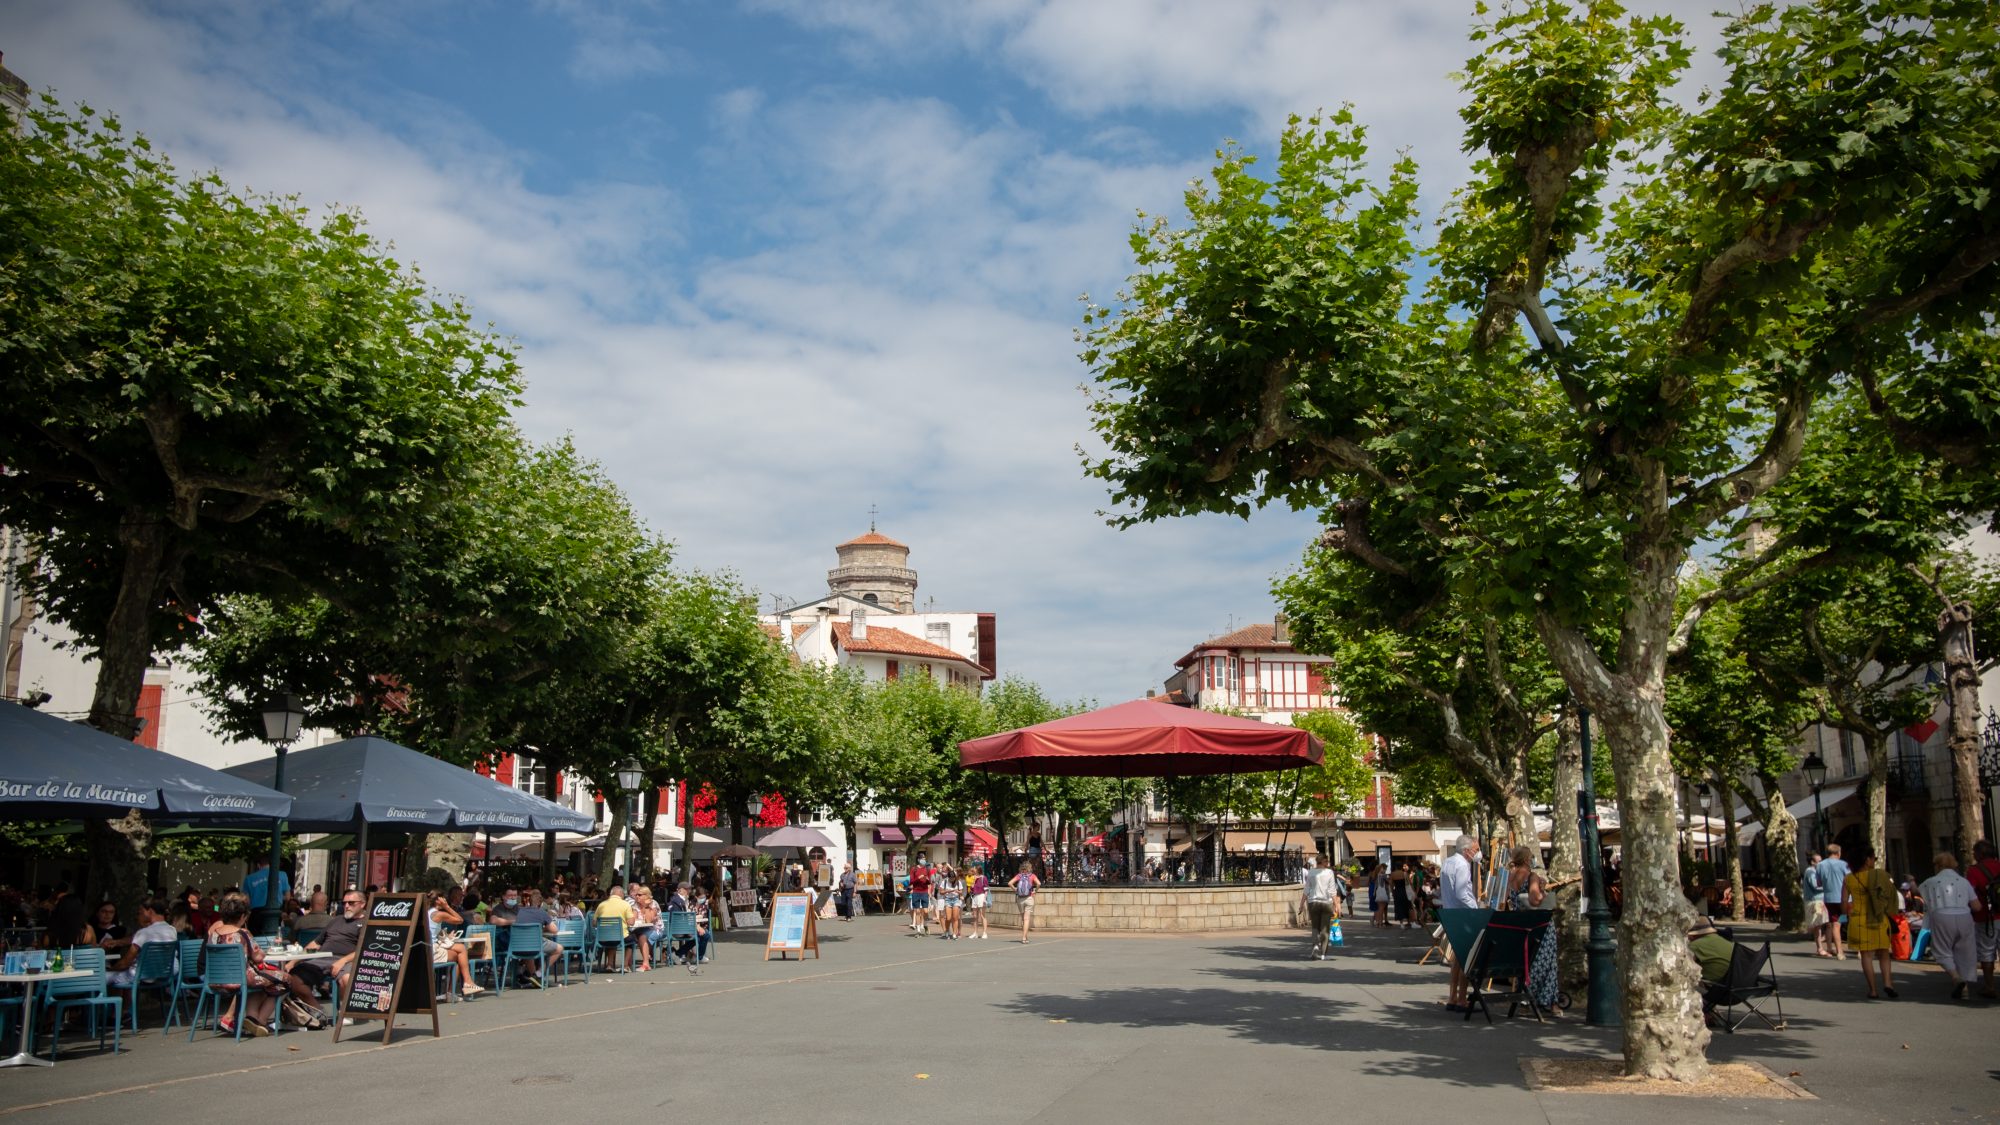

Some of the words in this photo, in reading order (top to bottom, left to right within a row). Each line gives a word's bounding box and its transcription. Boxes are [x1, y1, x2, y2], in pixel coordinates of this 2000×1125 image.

[0, 780, 32, 797] Bar
[36, 781, 60, 797] de
[63, 782, 83, 798] la
[86, 784, 147, 804] Marine
[202, 794, 257, 809] Cocktails
[386, 807, 428, 819] Brasserie
[459, 811, 475, 823] Bar
[478, 811, 486, 821] de
[487, 811, 495, 822] la
[498, 812, 525, 825] Marine
[550, 817, 576, 827] Cocktails
